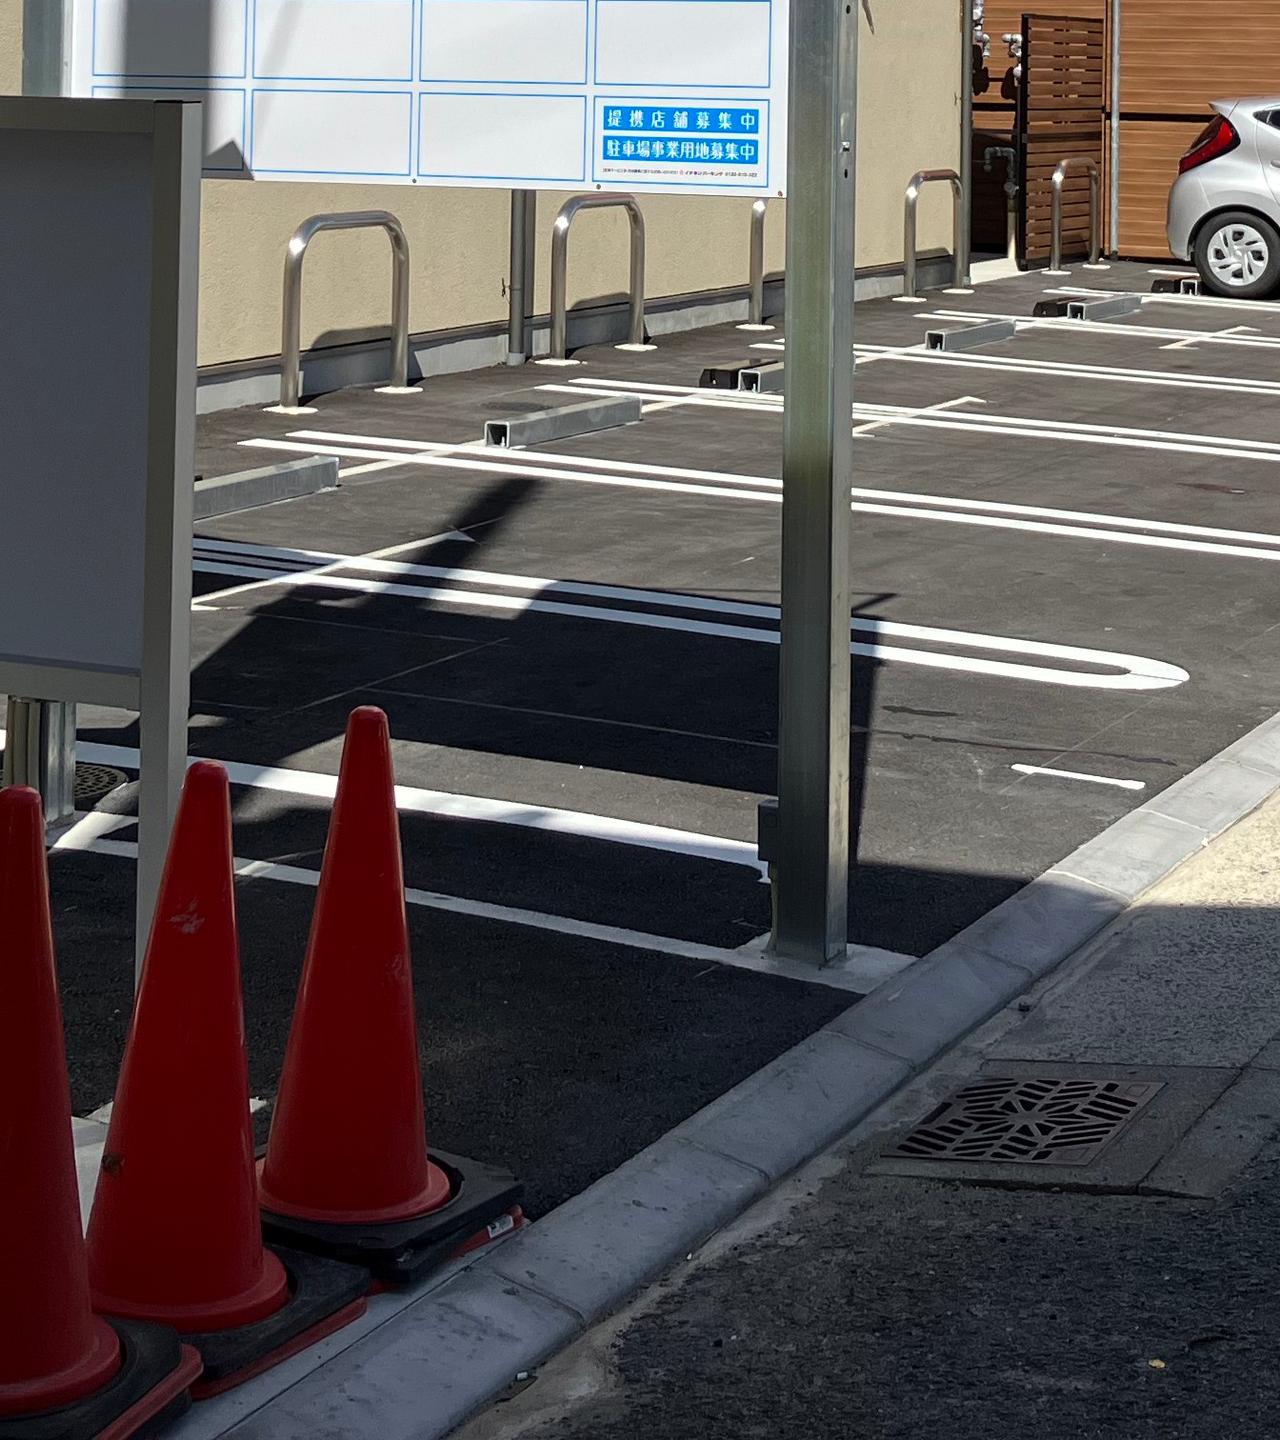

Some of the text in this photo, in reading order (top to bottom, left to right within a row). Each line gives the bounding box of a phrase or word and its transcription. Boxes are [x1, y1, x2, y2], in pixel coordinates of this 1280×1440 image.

[607, 110, 755, 130] 提携店舗募集中
[606, 139, 755, 161] 駐車場事業用地募集中
